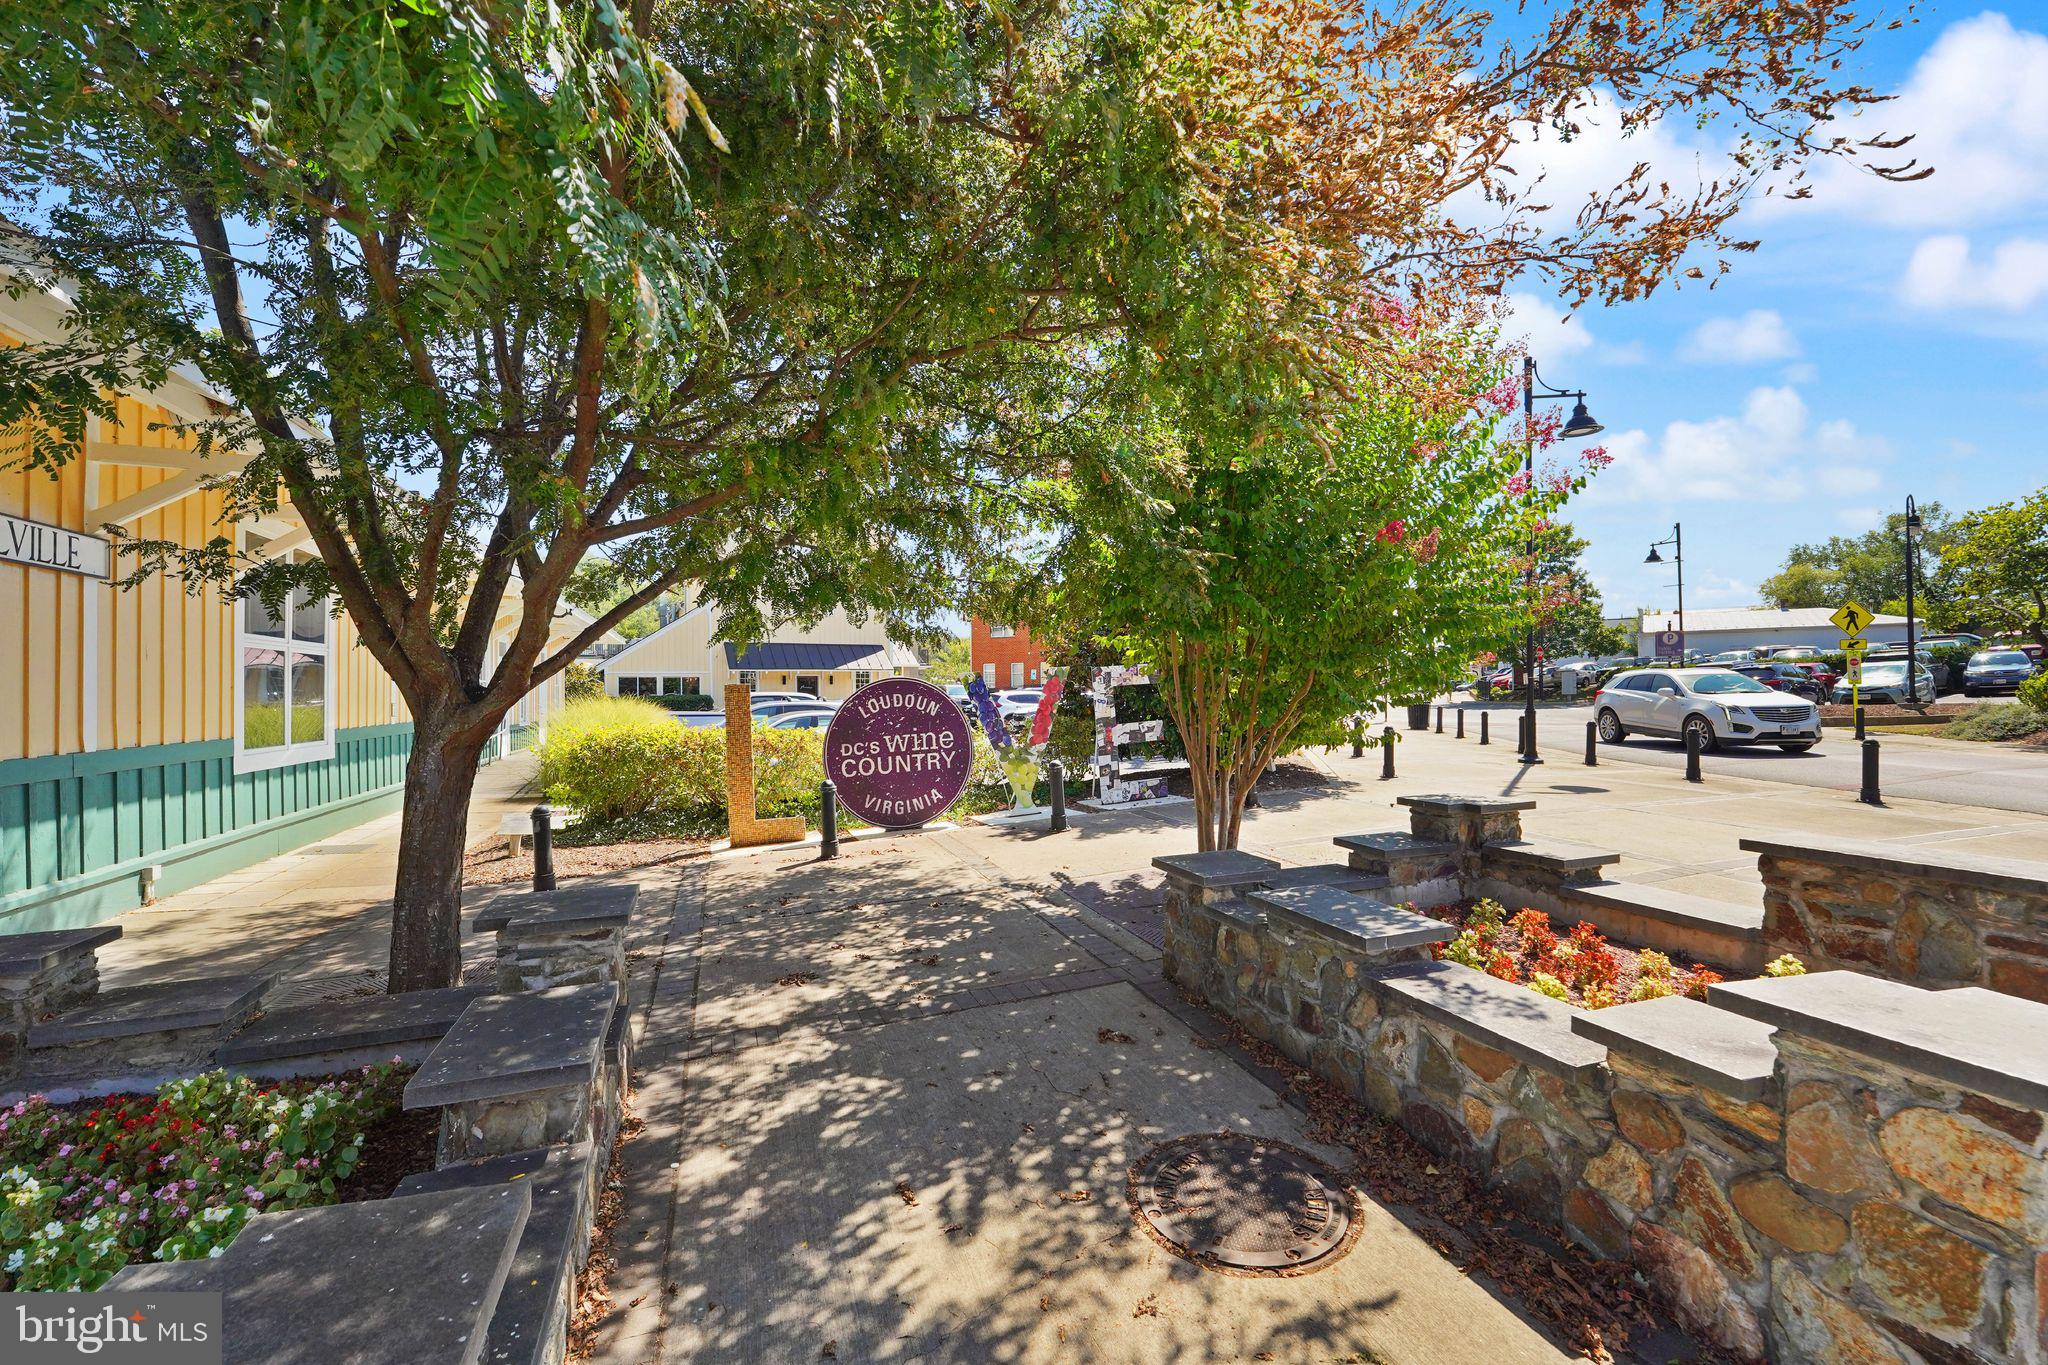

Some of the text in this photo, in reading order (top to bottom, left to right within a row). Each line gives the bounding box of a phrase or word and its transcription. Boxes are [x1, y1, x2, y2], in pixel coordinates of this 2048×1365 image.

[858, 693, 940, 718] LOUDOUN
[840, 741, 880, 757] DC'S
[841, 751, 956, 778] COUNTRY
[864, 788, 943, 815] VIRGINIA
[1293, 1188, 1327, 1240] SEWER
